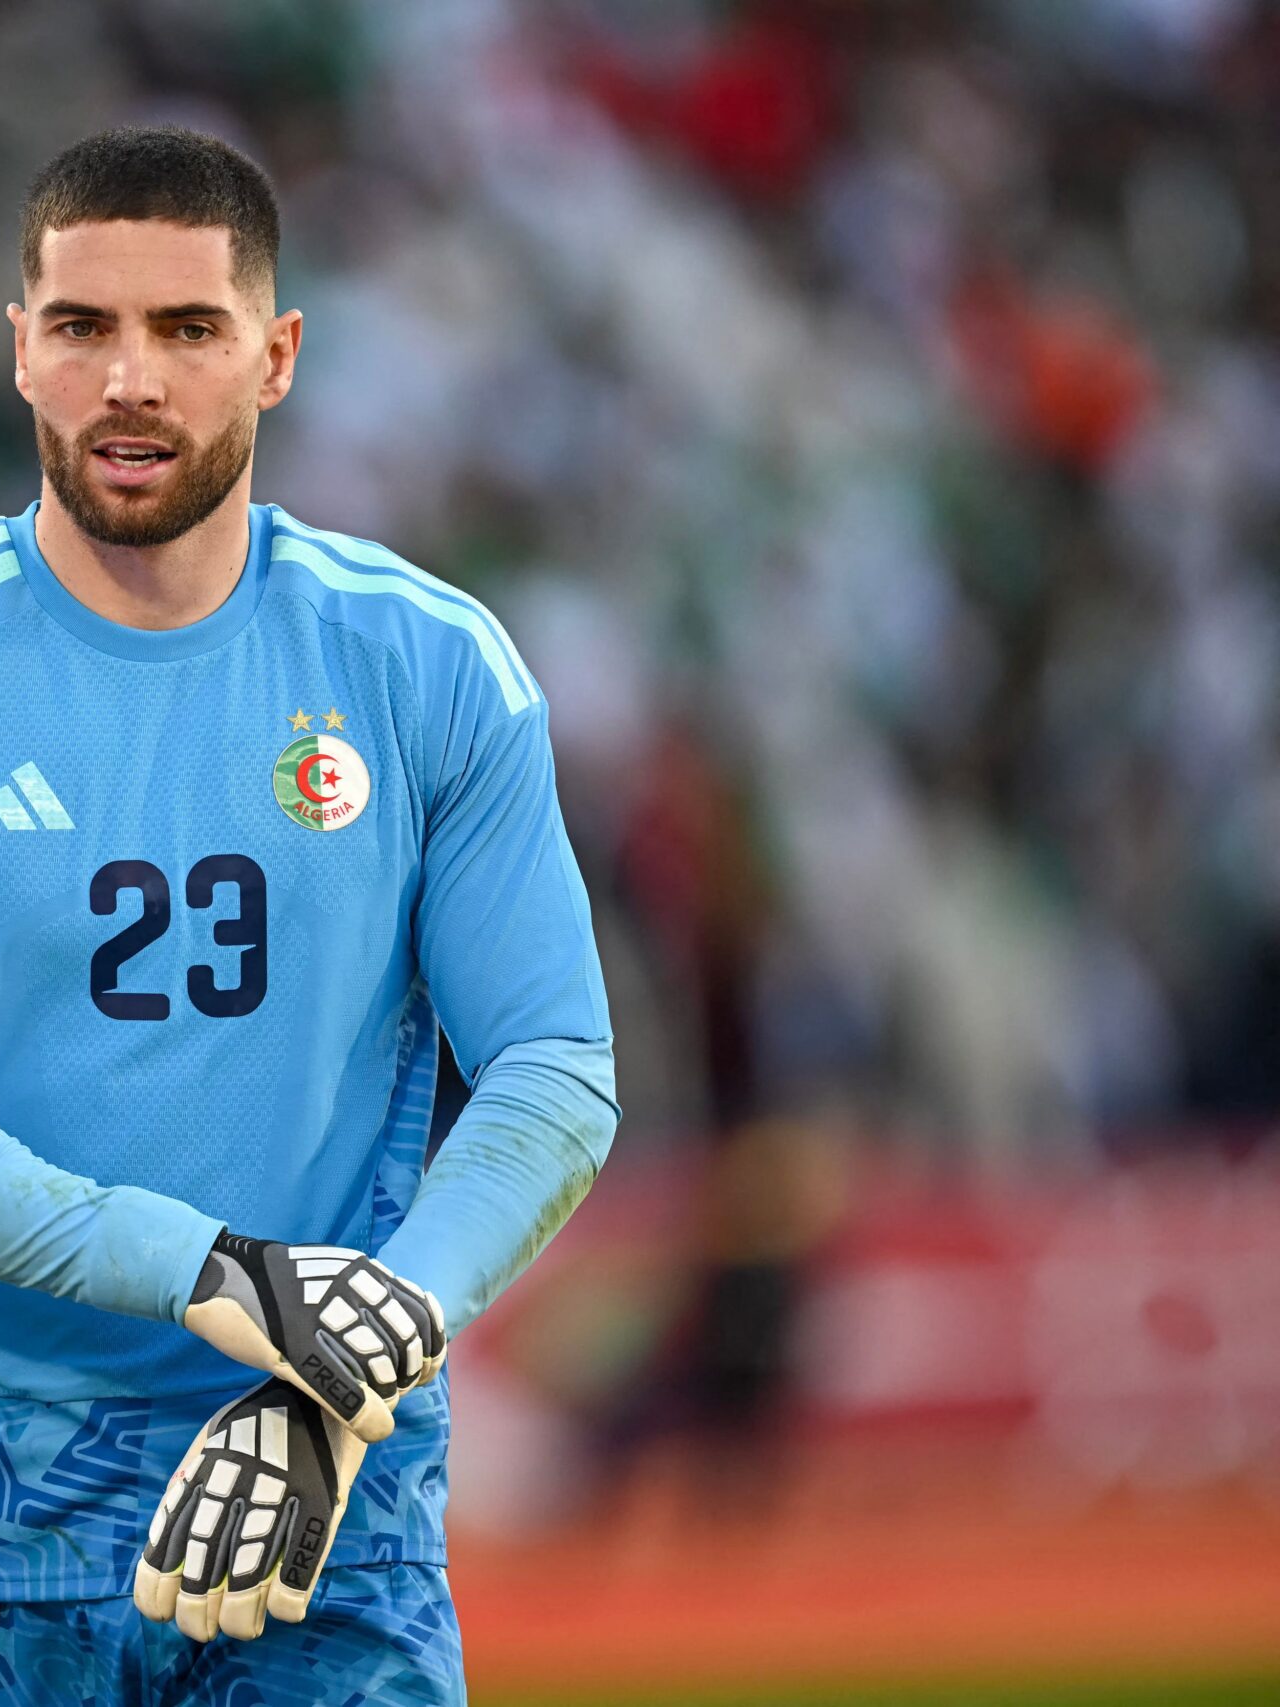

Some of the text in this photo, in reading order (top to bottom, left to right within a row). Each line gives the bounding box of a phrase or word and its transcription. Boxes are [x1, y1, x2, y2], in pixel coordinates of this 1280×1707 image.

[293, 801, 355, 822] ALGERIA
[89, 853, 268, 1021] 23
[302, 1353, 363, 1411] PRED
[285, 1516, 326, 1587] PRED
